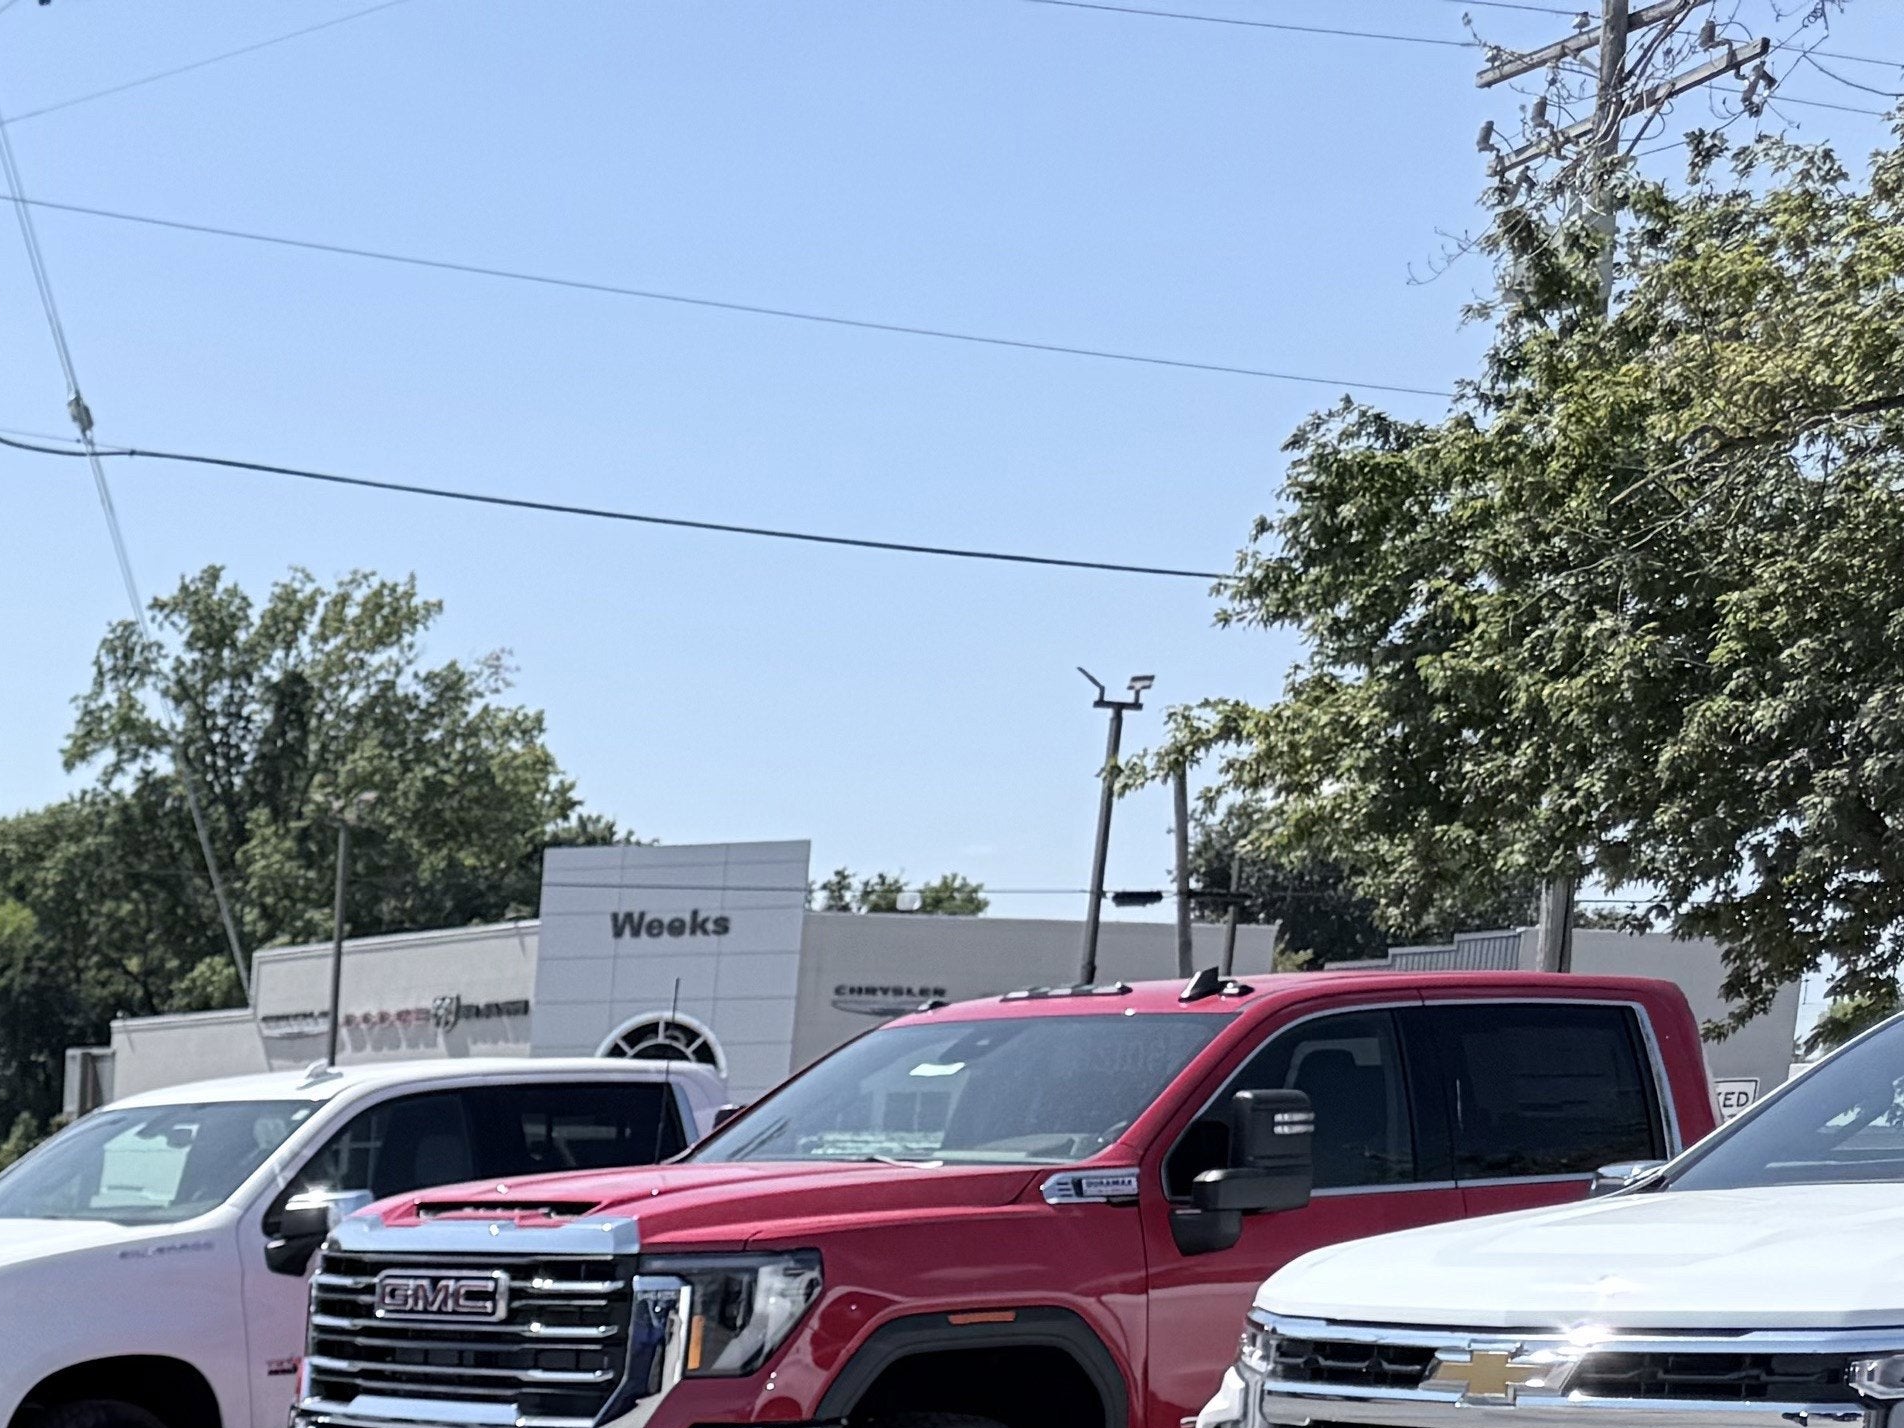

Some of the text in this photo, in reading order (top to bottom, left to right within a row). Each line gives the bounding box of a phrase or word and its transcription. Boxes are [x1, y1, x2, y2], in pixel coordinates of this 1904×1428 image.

[610, 908, 731, 939] Weeks
[834, 984, 947, 998] CHRYSLER
[1717, 1091, 1750, 1108] ED
[380, 1277, 496, 1313] GMC
